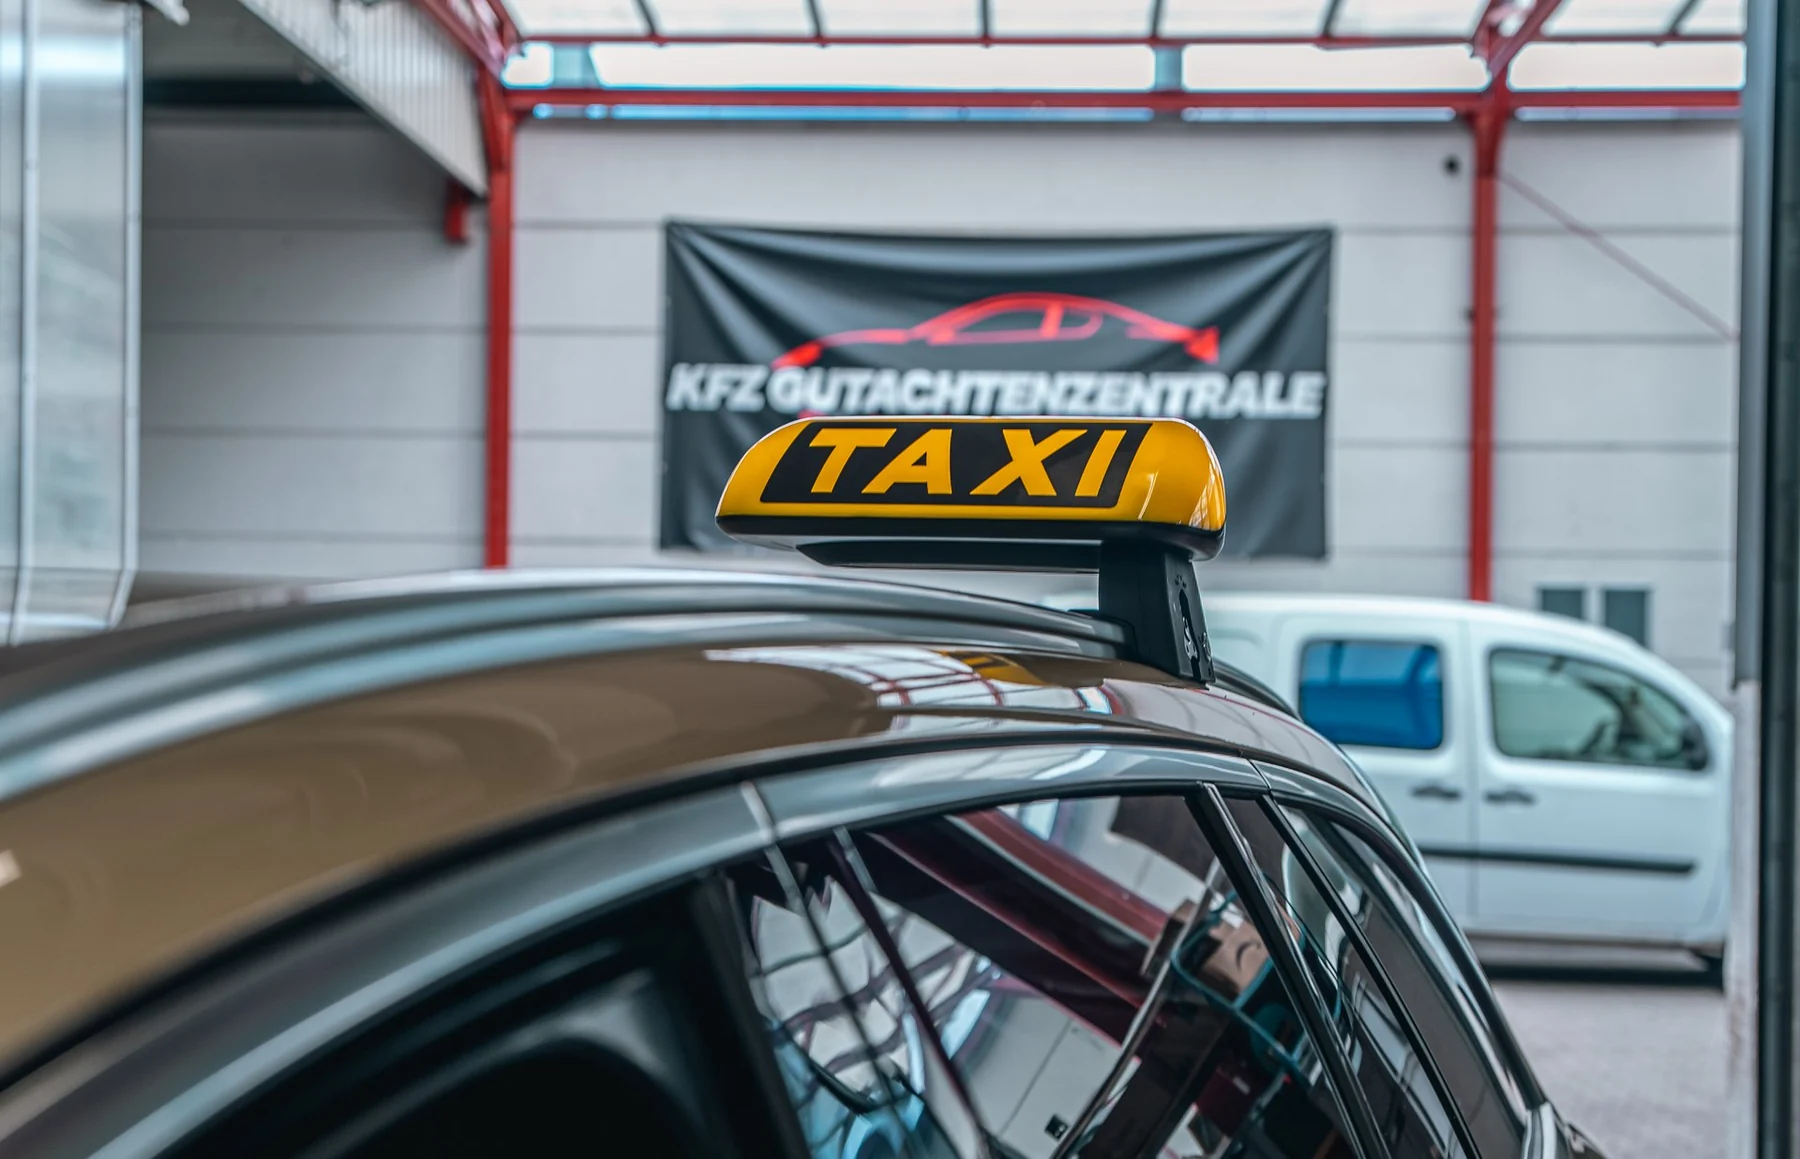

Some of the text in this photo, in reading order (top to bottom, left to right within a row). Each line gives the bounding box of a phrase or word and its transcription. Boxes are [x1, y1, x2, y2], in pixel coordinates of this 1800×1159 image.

[666, 363, 1327, 419] KFZ GUTACHTENZENTRALE
[809, 428, 1127, 497] TAXI
